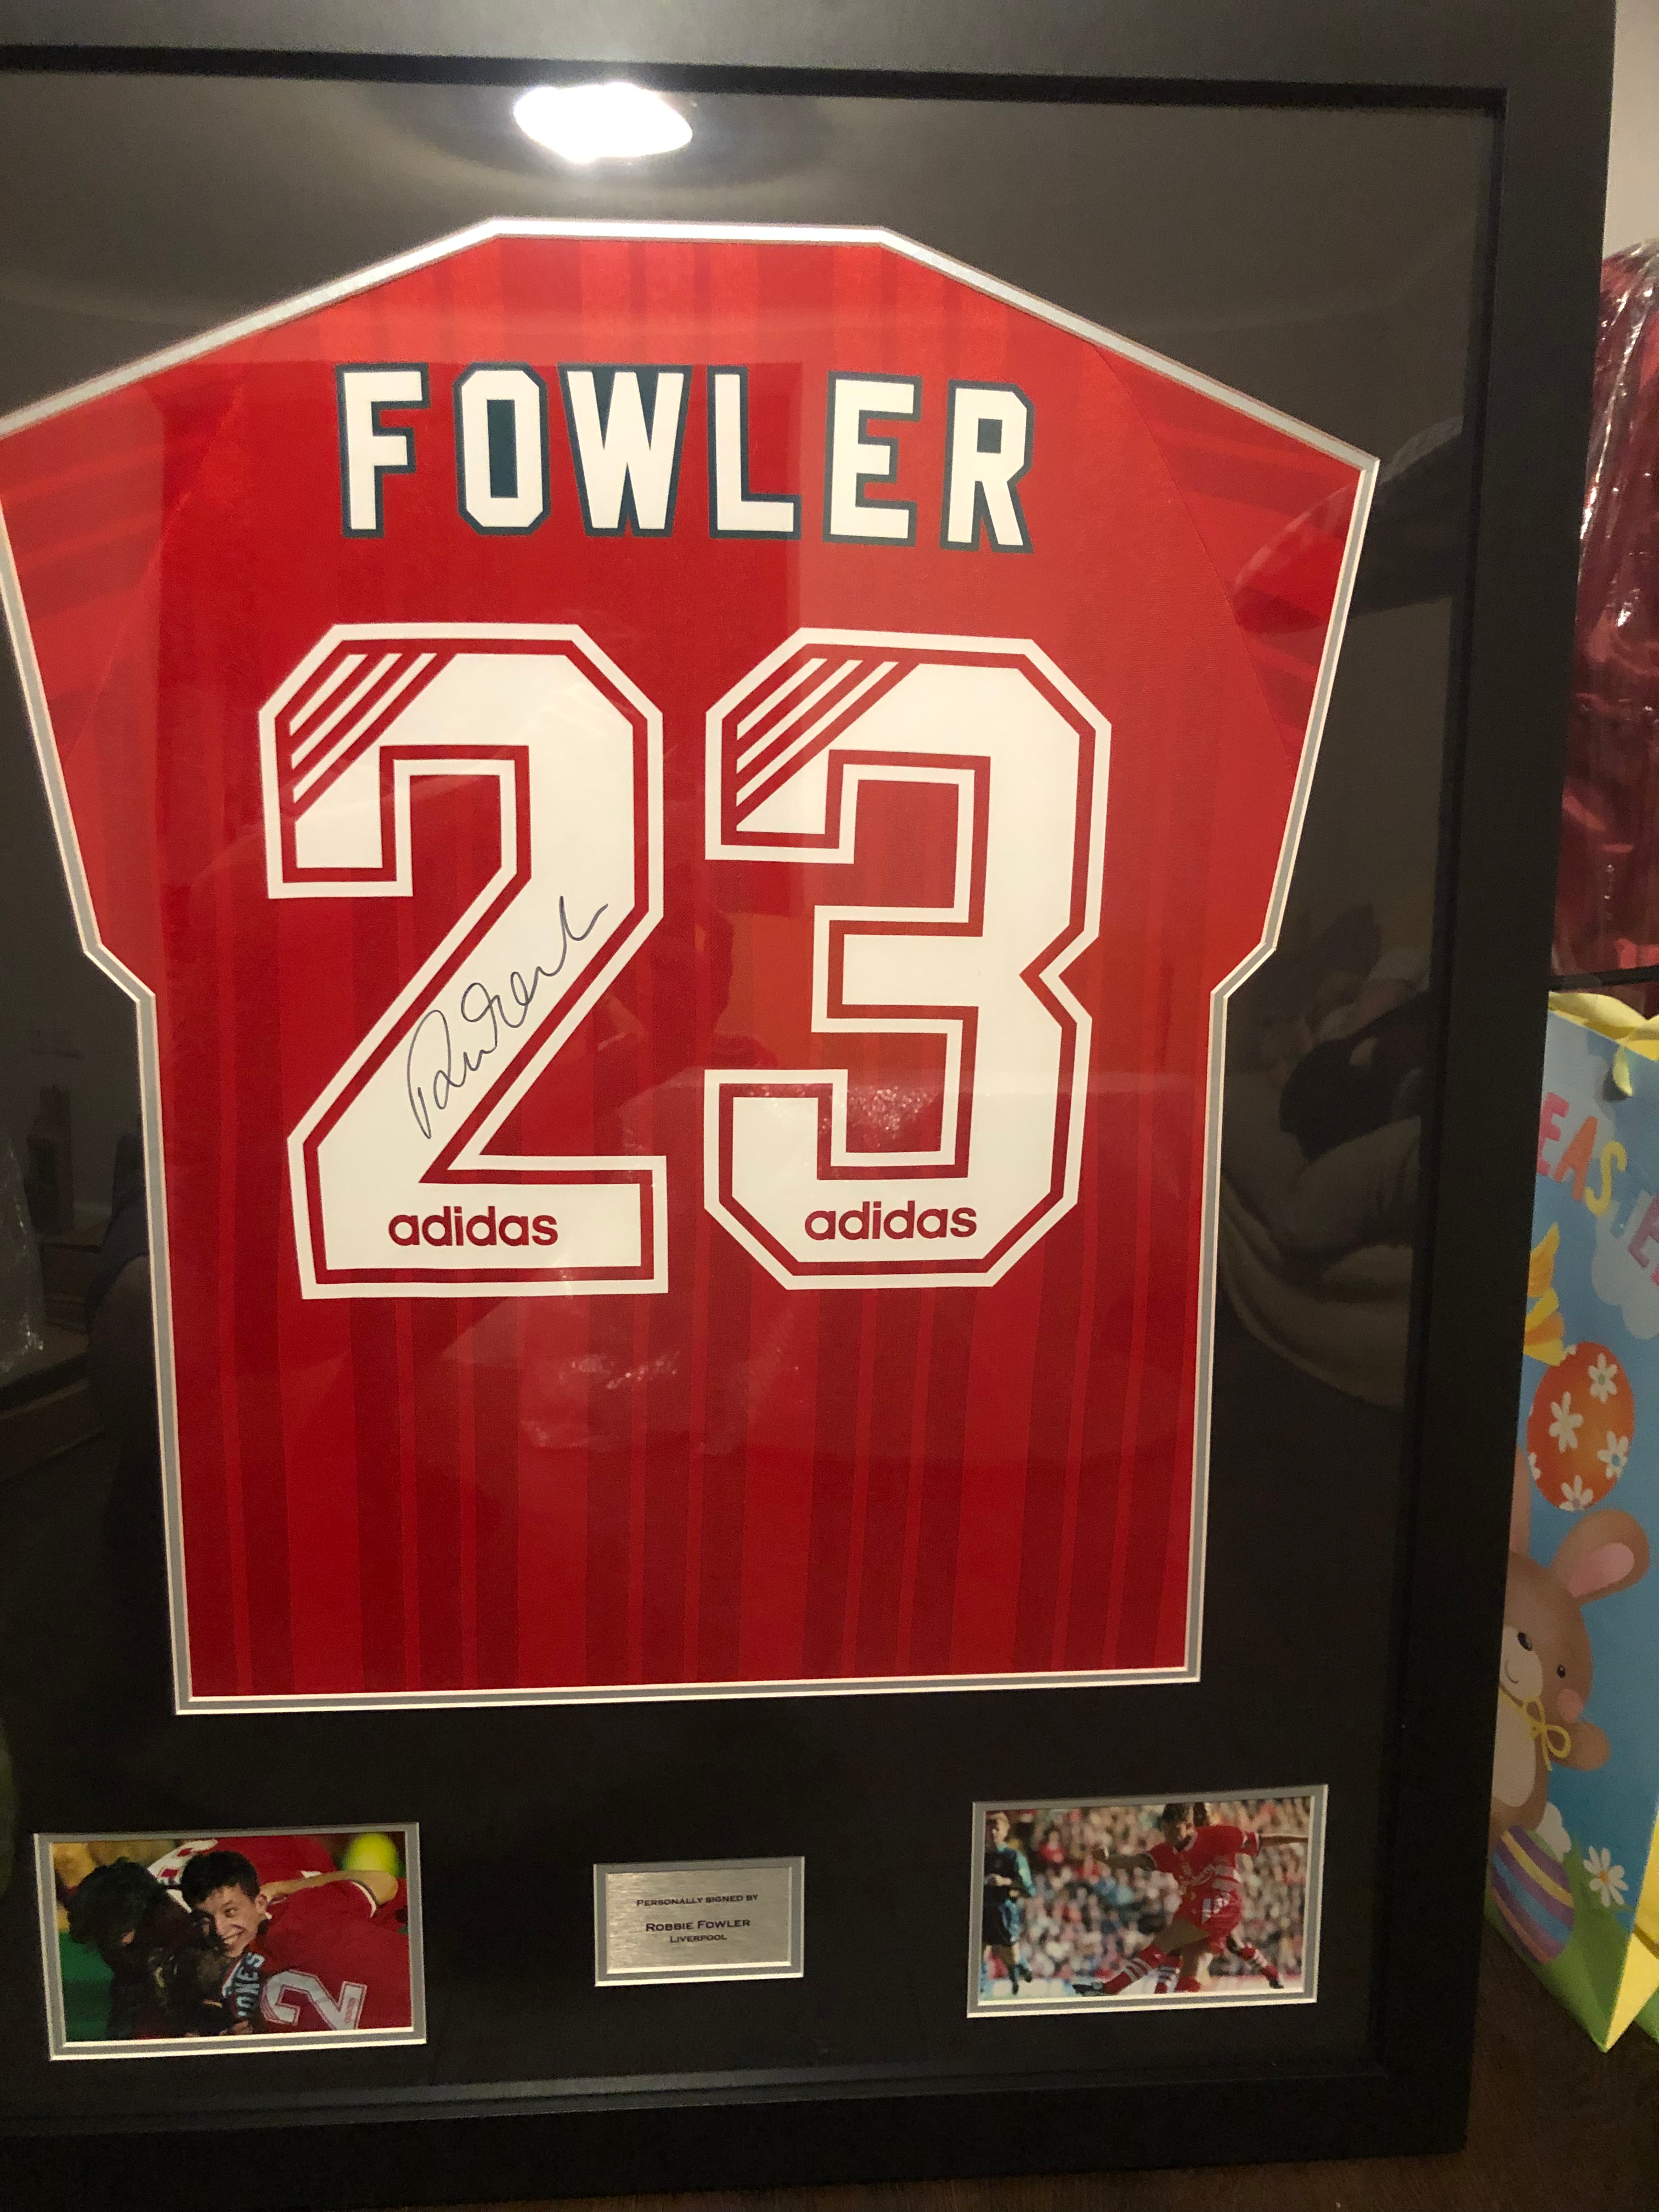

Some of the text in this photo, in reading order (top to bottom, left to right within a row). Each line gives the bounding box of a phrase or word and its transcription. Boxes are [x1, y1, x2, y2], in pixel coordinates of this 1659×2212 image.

[335, 362, 1034, 554] FOWLER
[258, 623, 1112, 1299] 23
[1536, 1092, 1659, 1286] EAST
[387, 1205, 559, 1247] adidas
[804, 1200, 978, 1241] adidas
[636, 1897, 703, 1906] PERSONALLY
[705, 1894, 743, 1904] SIGNED
[645, 1919, 751, 1932] ROBBIE FOWLER
[670, 1934, 727, 1943] LIVERPOOL
